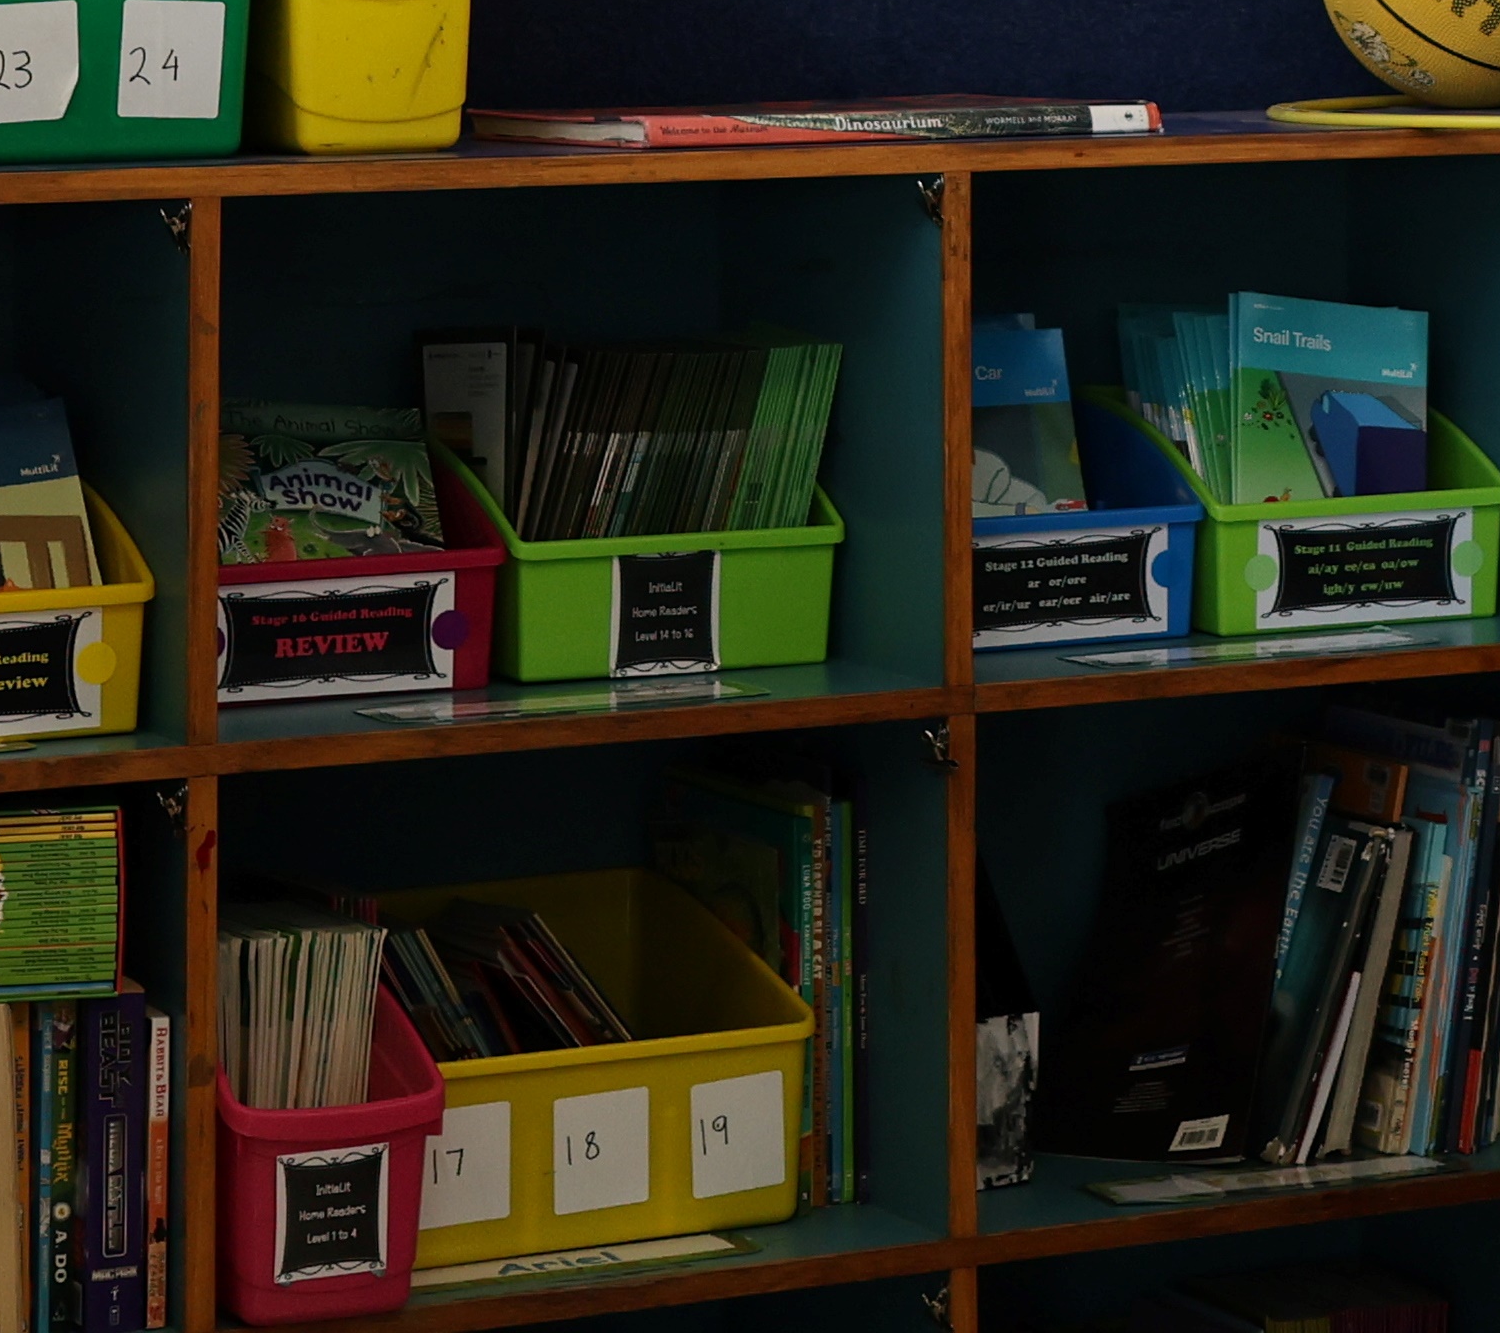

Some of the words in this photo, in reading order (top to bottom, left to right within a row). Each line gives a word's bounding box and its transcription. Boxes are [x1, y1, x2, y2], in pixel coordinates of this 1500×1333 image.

[128, 49, 179, 86] 24
[1253, 326, 1290, 346] Snail
[1293, 331, 1332, 351] Trails
[269, 468, 373, 502] Animal
[985, 560, 1018, 572] Stage
[1036, 554, 1079, 568] Guided
[1081, 551, 1129, 564] Reading
[1294, 544, 1325, 556] Stage
[1346, 540, 1386, 552] Guided
[1388, 537, 1434, 549] Reading
[274, 631, 391, 658] REVIEW
[1157, 828, 1243, 871] UNIVERSE
[566, 1131, 601, 1165] 18
[700, 1115, 729, 1156] 19
[432, 1148, 464, 1184] 17
[498, 1250, 626, 1276] Ariel
